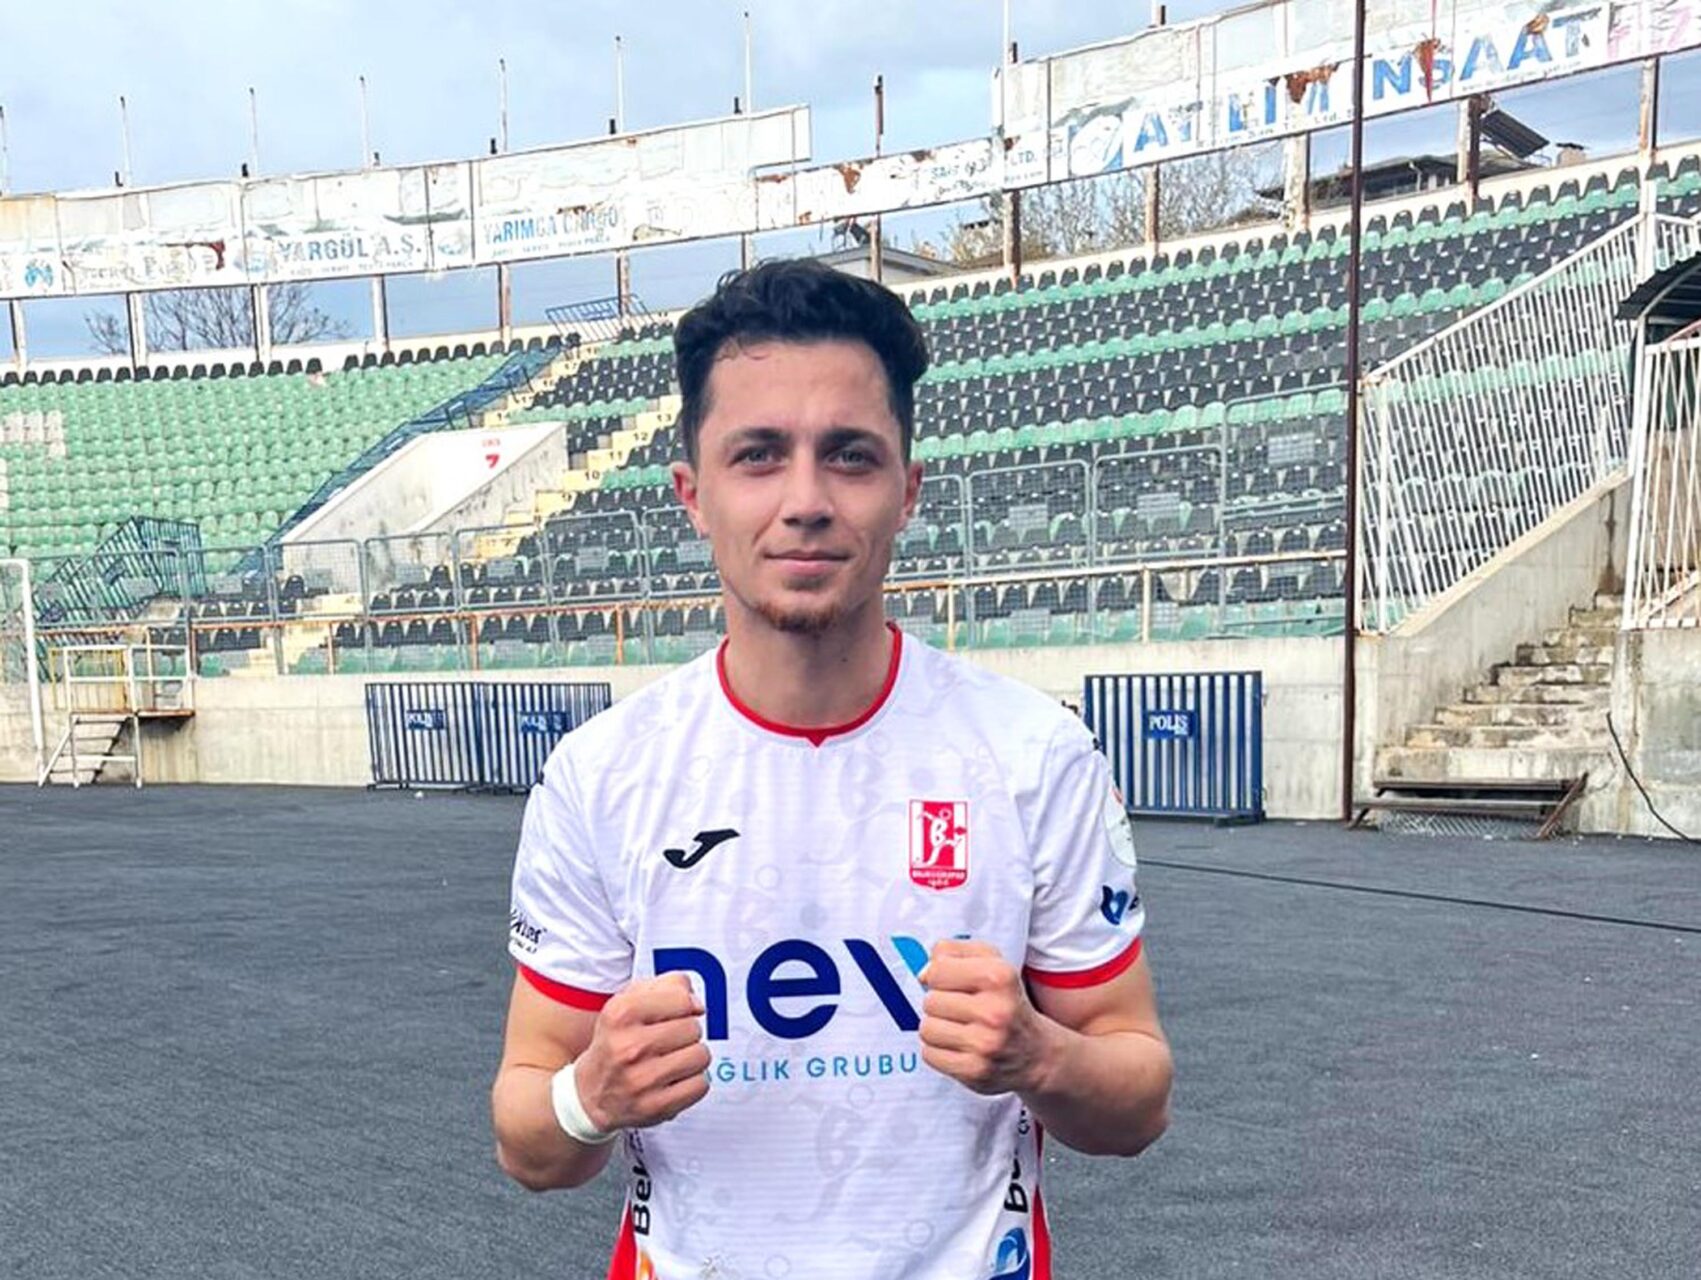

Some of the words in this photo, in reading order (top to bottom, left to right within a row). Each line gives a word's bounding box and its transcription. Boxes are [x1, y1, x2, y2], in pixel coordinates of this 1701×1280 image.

[633, 431, 649, 441] 12
[584, 470, 600, 481] 10
[704, 1056, 790, 1083] ĞLIK
[806, 1051, 919, 1078] GRUBU
